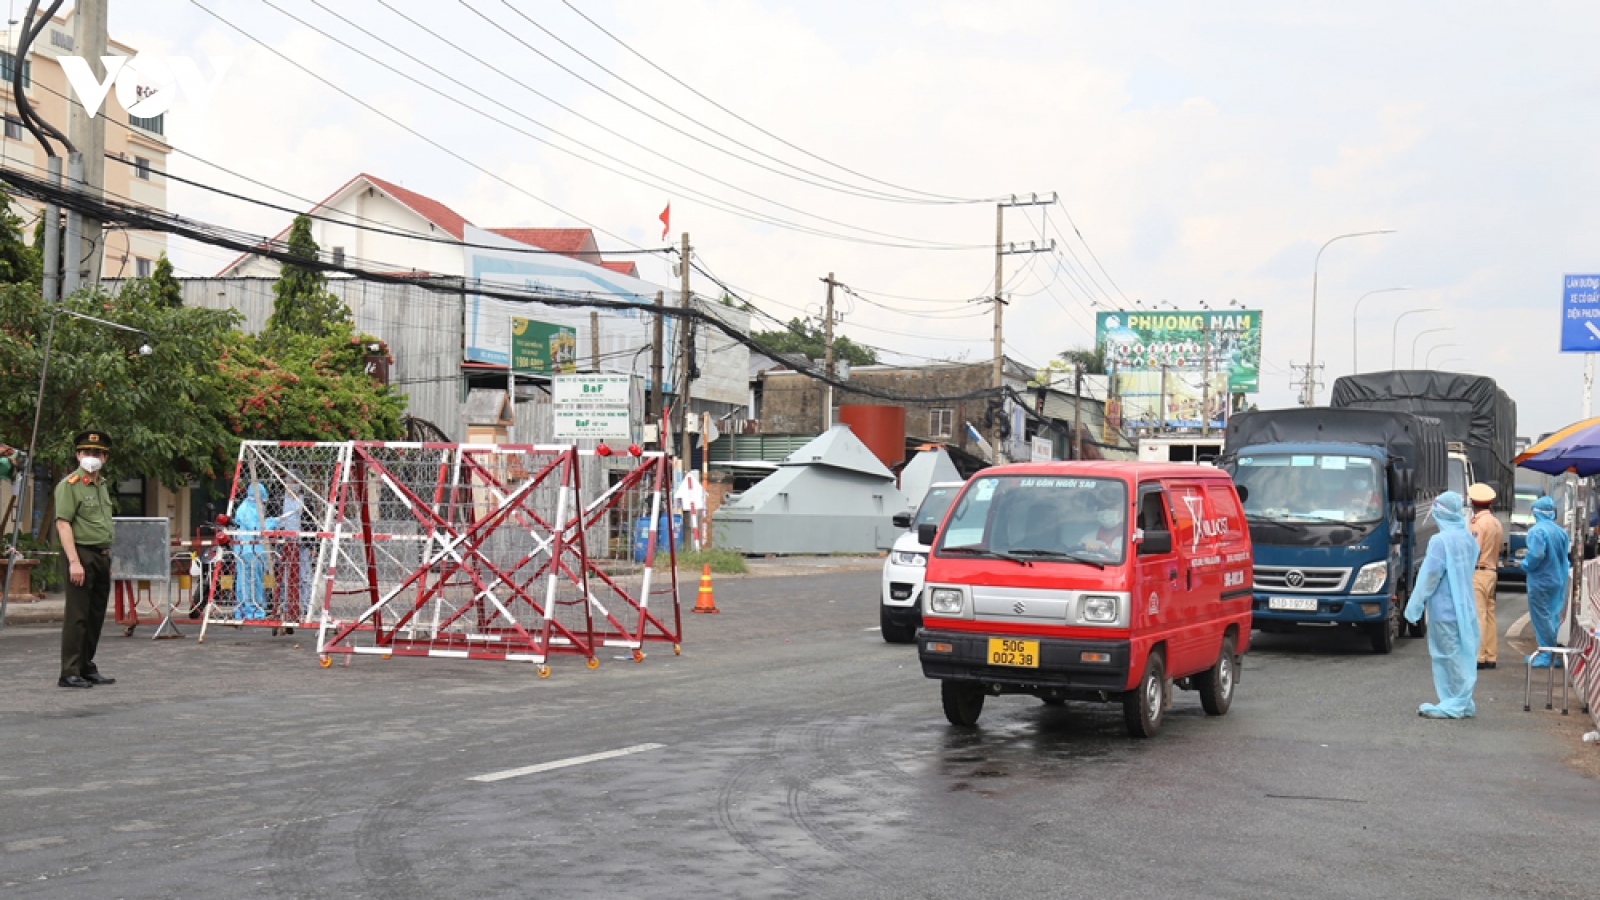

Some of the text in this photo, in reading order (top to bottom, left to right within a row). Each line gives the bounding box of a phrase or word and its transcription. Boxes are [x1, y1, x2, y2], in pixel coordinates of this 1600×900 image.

[1210, 315, 1251, 330] NAM
[1003, 640, 1025, 652] 50G
[993, 652, 1033, 665] 002.38
